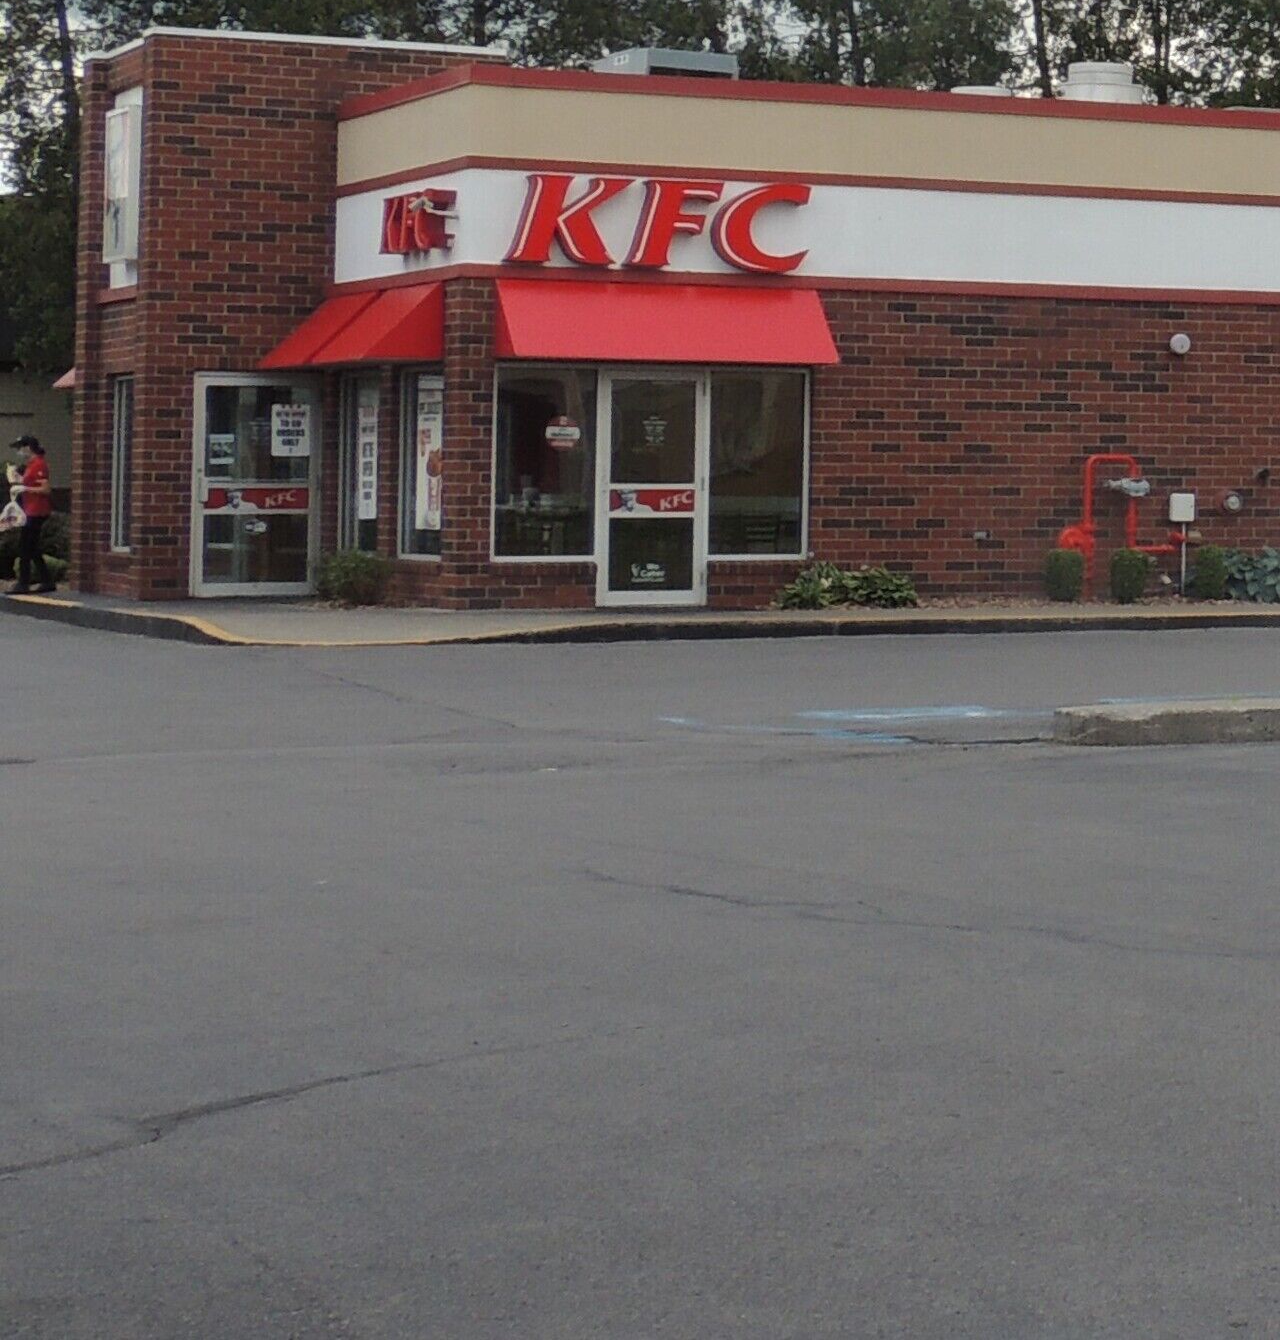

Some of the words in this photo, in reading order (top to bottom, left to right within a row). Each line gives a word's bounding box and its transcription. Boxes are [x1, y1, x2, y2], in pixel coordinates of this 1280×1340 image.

[500, 174, 810, 274] KFC
[264, 489, 297, 508] KFC
[660, 491, 692, 511] KFC
